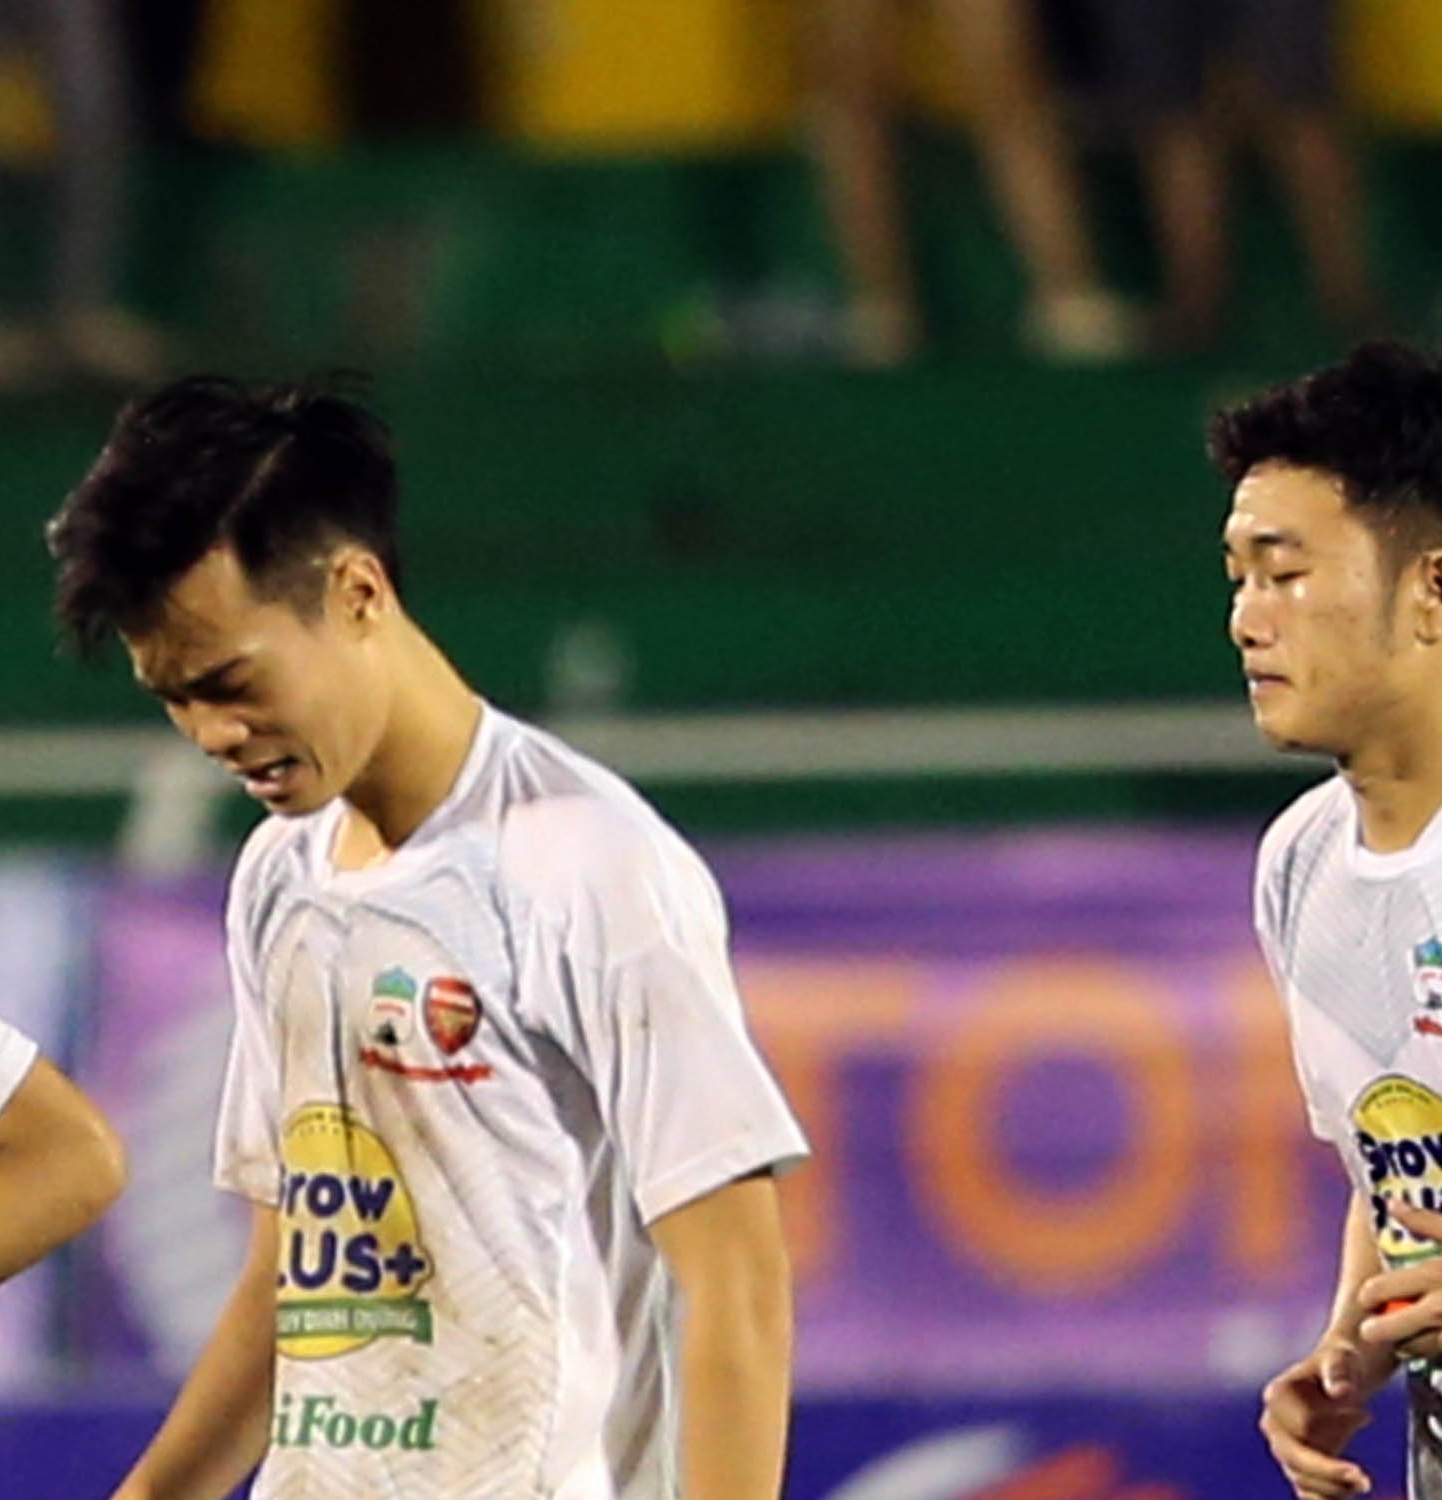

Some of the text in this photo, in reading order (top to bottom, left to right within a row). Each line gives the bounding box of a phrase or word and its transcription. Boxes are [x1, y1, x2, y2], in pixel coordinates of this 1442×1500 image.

[269, 1166, 395, 1222] row
[268, 1229, 426, 1293] US+
[271, 1394, 439, 1452] iFood
